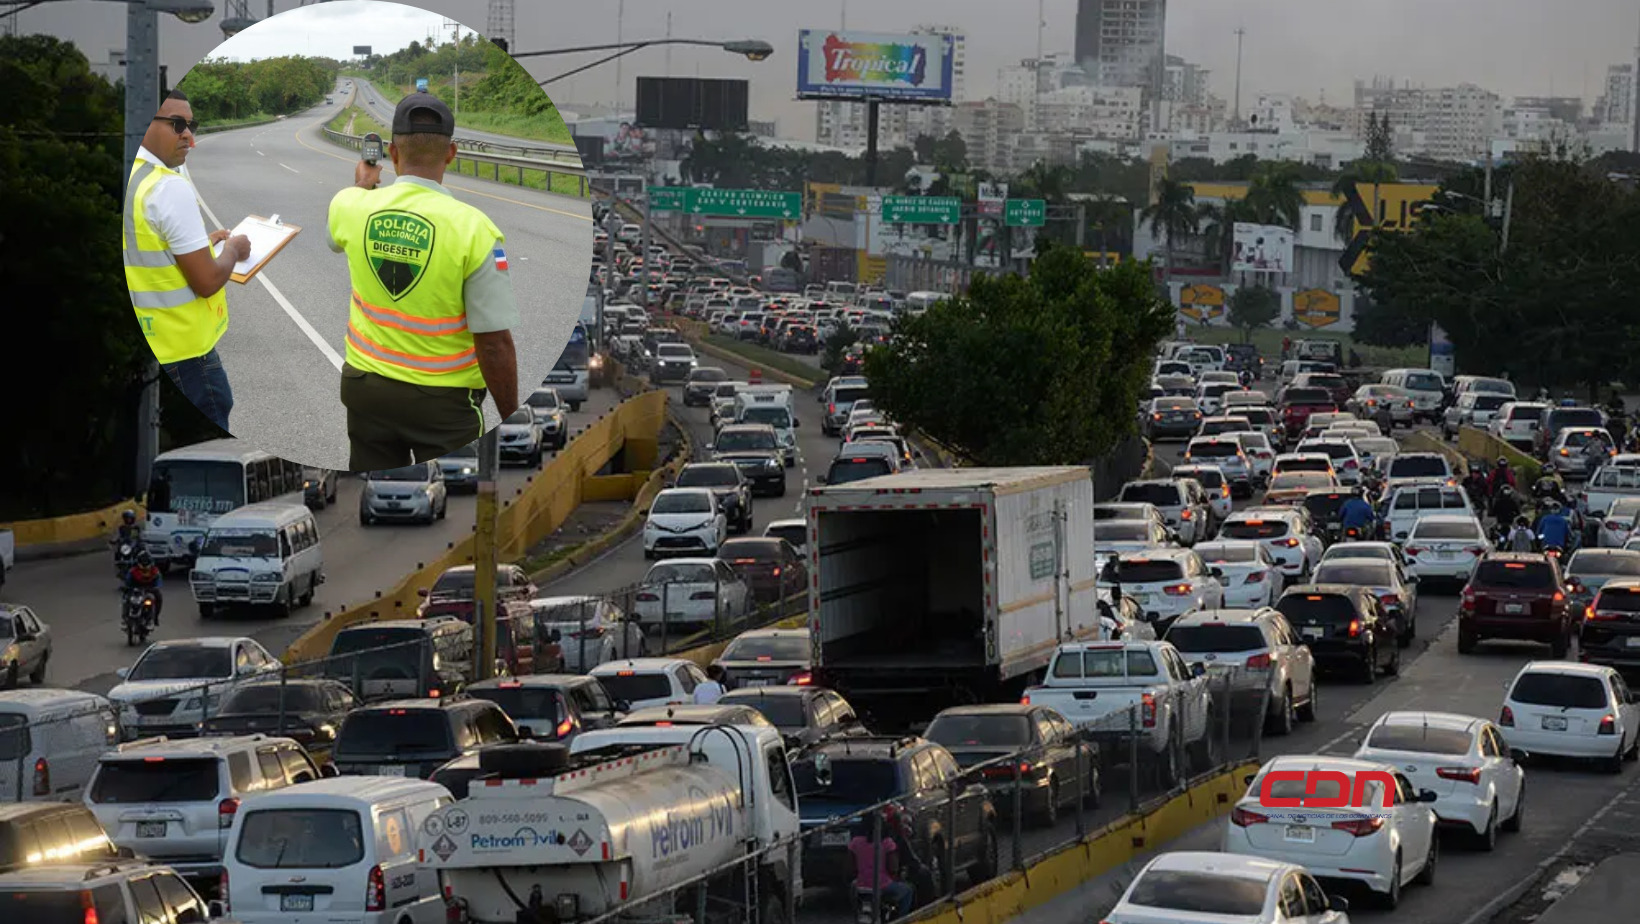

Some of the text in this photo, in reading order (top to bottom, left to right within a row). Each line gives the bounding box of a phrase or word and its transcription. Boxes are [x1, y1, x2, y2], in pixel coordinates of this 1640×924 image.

[831, 48, 921, 80] Tropical
[373, 218, 429, 240] POLICIA
[378, 230, 420, 245] NACIONAL
[373, 242, 422, 258] DIGESETT
[170, 498, 213, 511] MAESTRO
